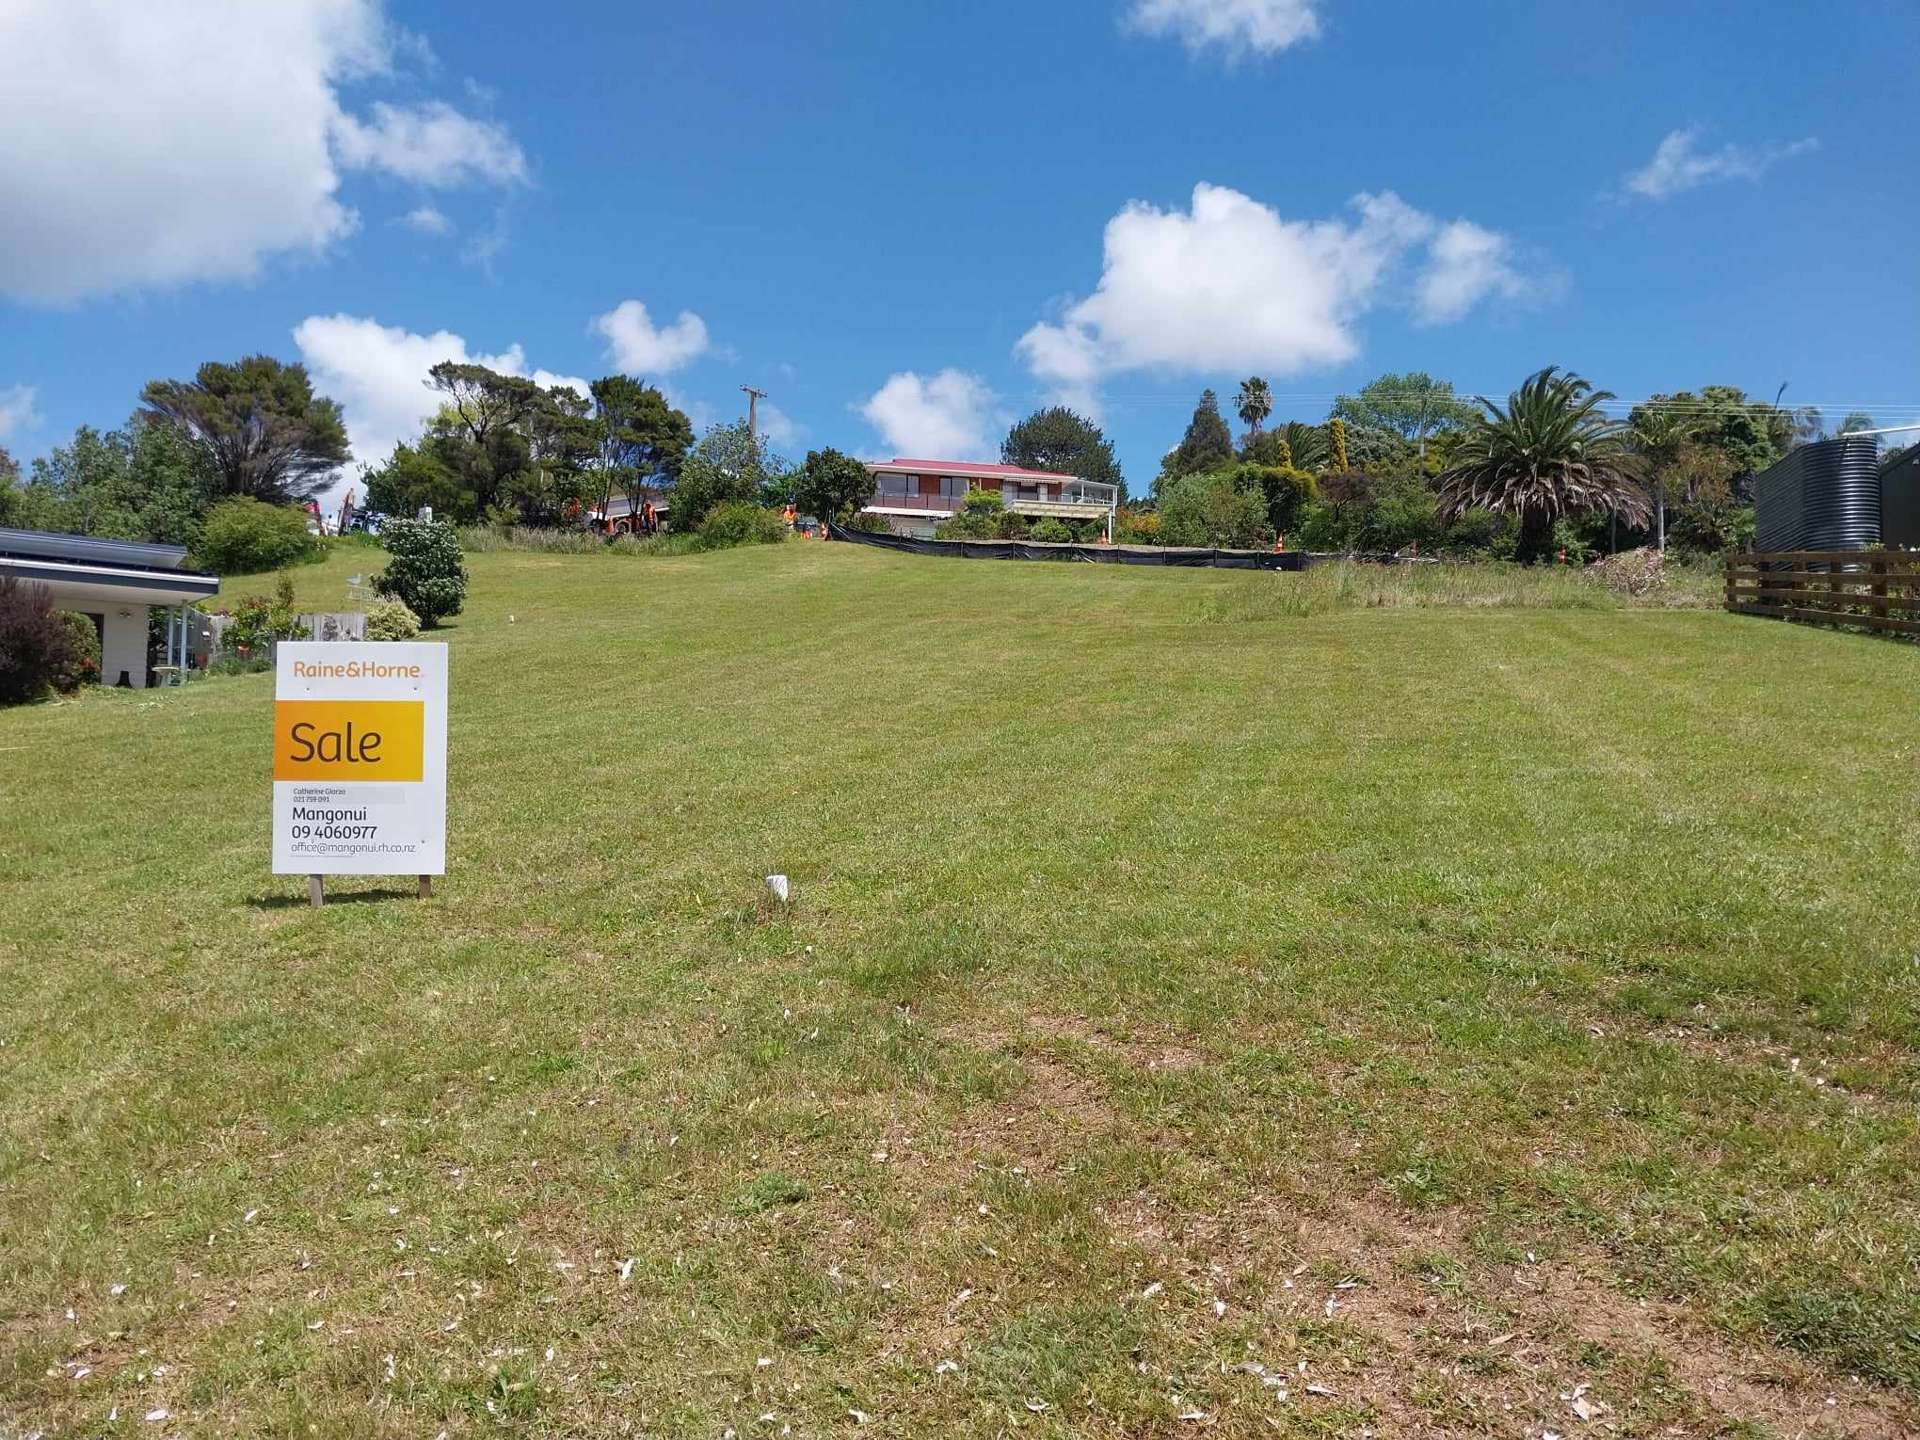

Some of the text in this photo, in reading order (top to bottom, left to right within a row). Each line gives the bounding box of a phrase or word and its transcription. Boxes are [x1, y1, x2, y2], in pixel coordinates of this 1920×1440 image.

[293, 660, 421, 678] Raine&Horne
[290, 721, 382, 763] Sale
[293, 787, 324, 795] Catherine
[292, 806, 367, 825] Mangonui
[291, 825, 378, 839] 09 4060977
[291, 842, 416, 855] office@mangonui.rh.co.nz
